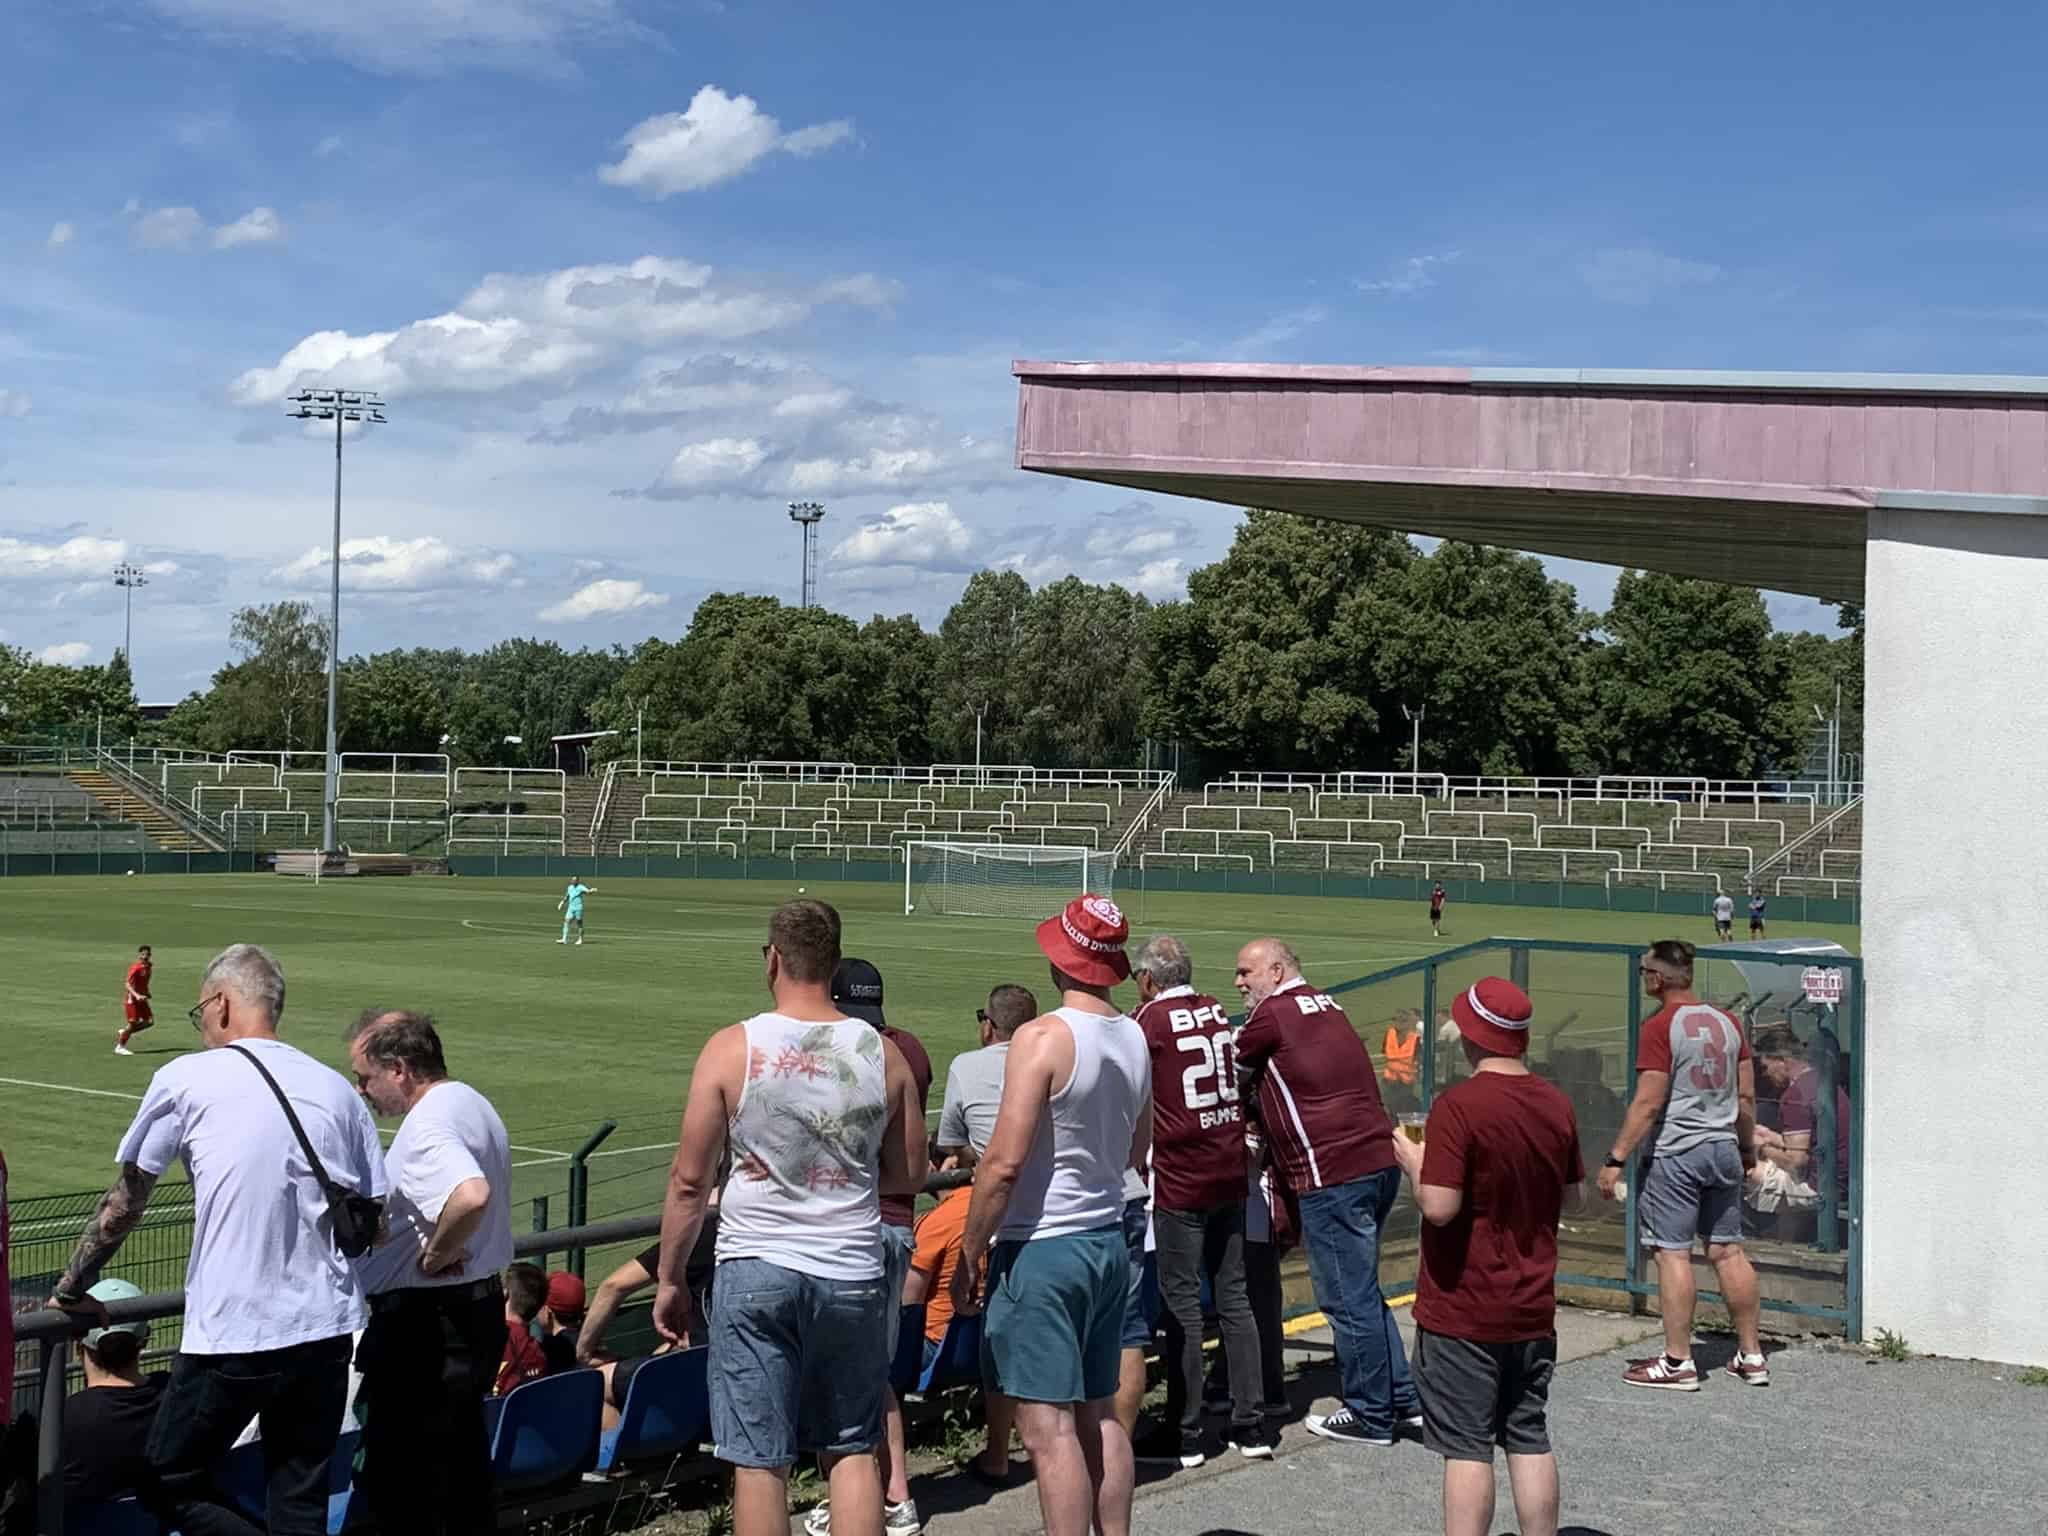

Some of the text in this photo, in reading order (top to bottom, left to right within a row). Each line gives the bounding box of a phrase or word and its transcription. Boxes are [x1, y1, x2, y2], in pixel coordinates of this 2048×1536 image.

[1168, 1004, 1228, 1032] BFC
[1683, 1012, 1727, 1090] 3
[1177, 1031, 1239, 1110] 20
